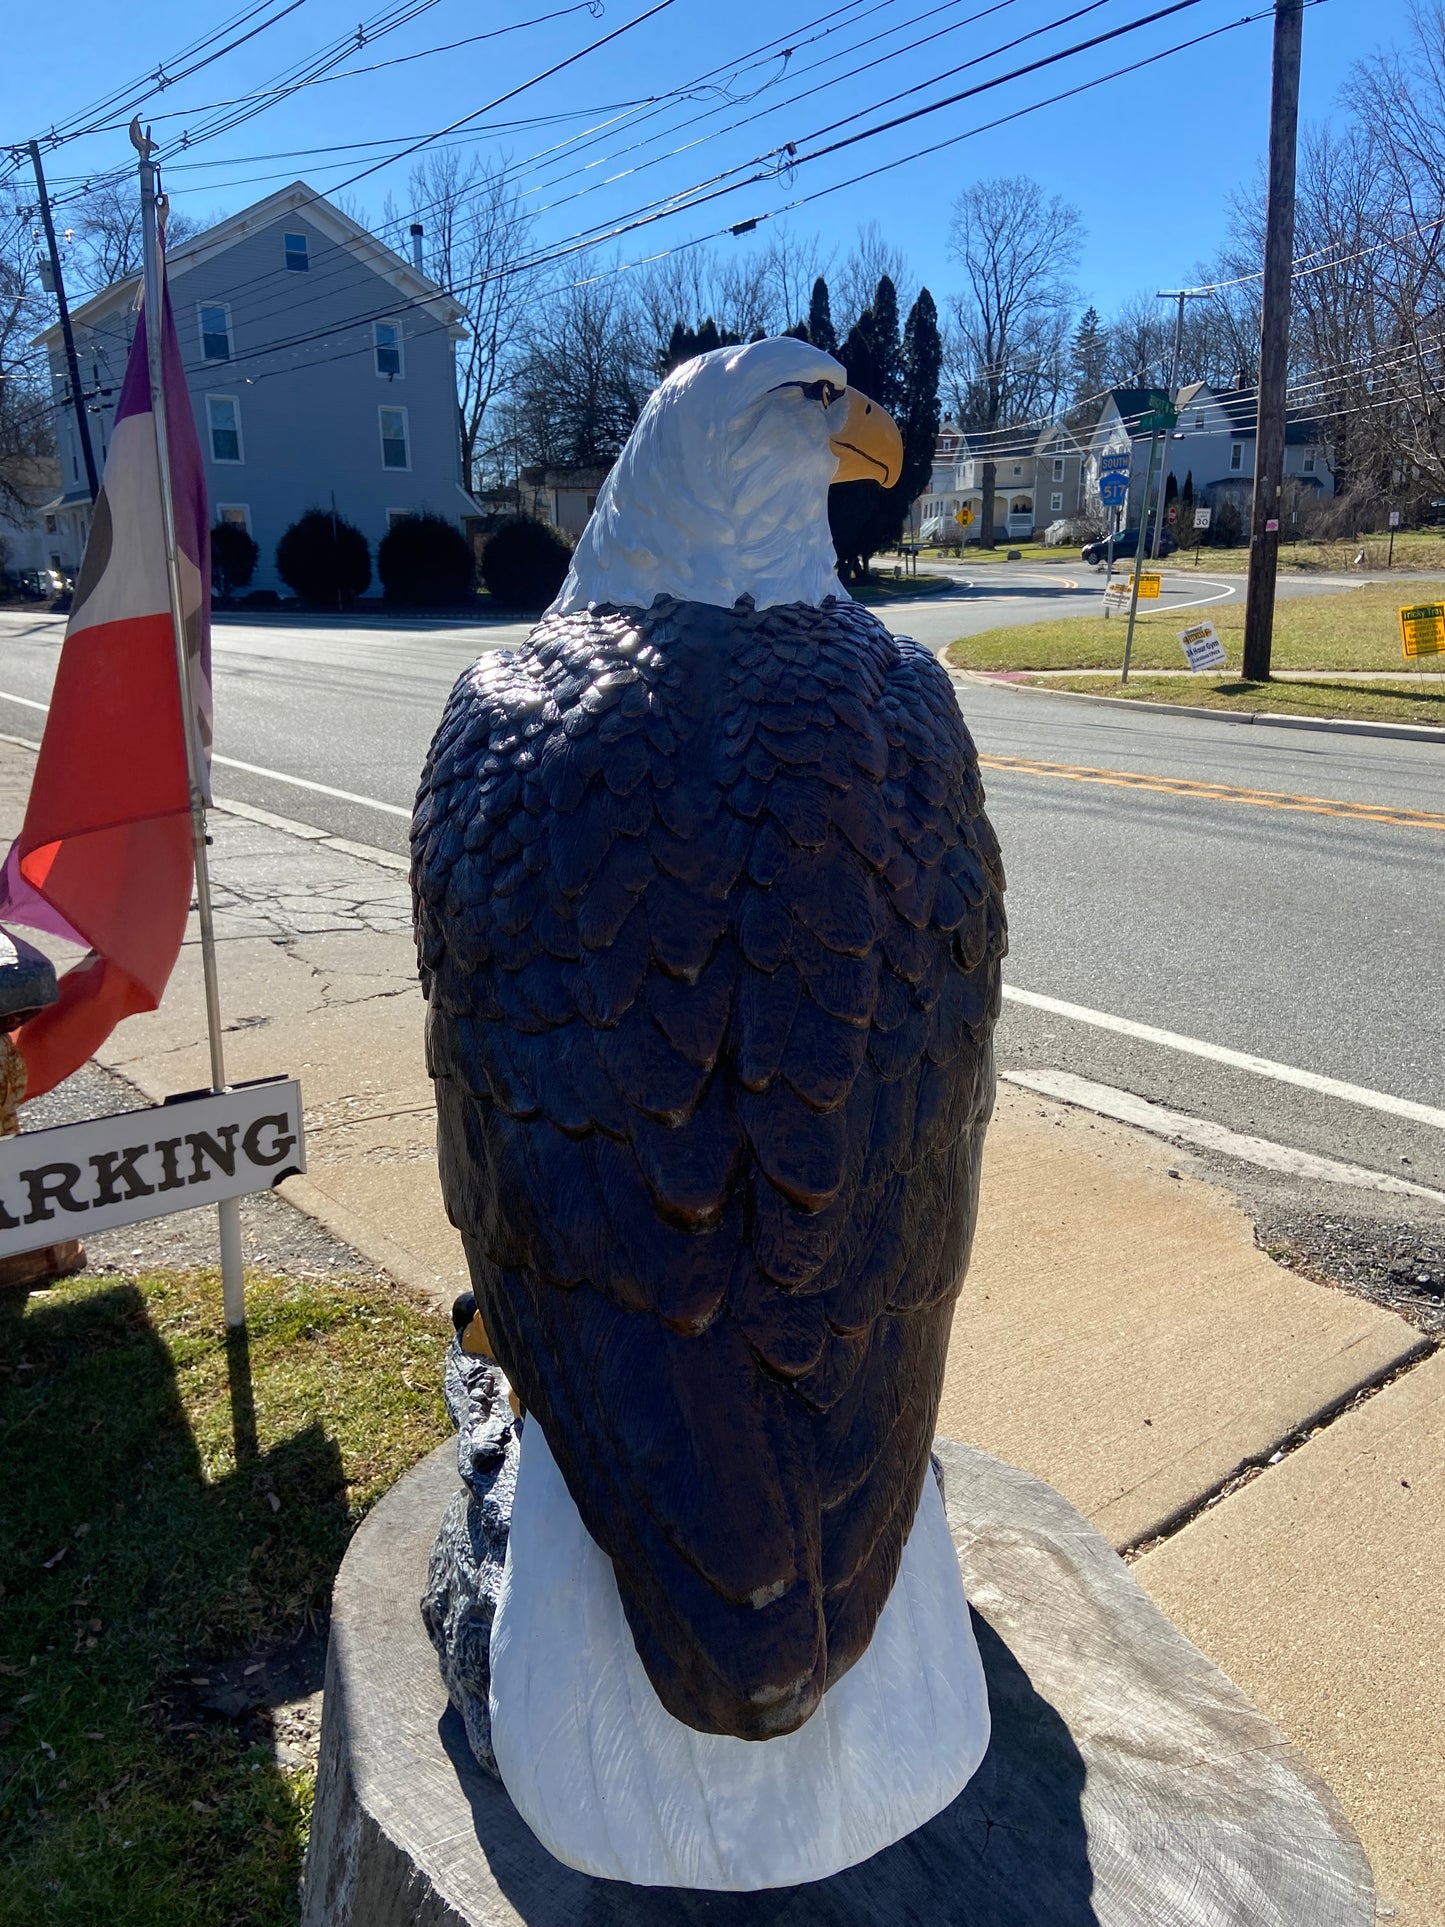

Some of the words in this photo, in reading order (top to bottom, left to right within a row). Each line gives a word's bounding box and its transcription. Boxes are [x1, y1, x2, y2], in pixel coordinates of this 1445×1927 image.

[1102, 456, 1128, 469] SOUTH
[1103, 485, 1126, 499] 517
[1196, 518, 1208, 526] 30
[1404, 610, 1425, 620] Tricky
[1427, 607, 1443, 617] Tray
[1192, 646, 1206, 655] Hour
[1206, 640, 1219, 650] Gym
